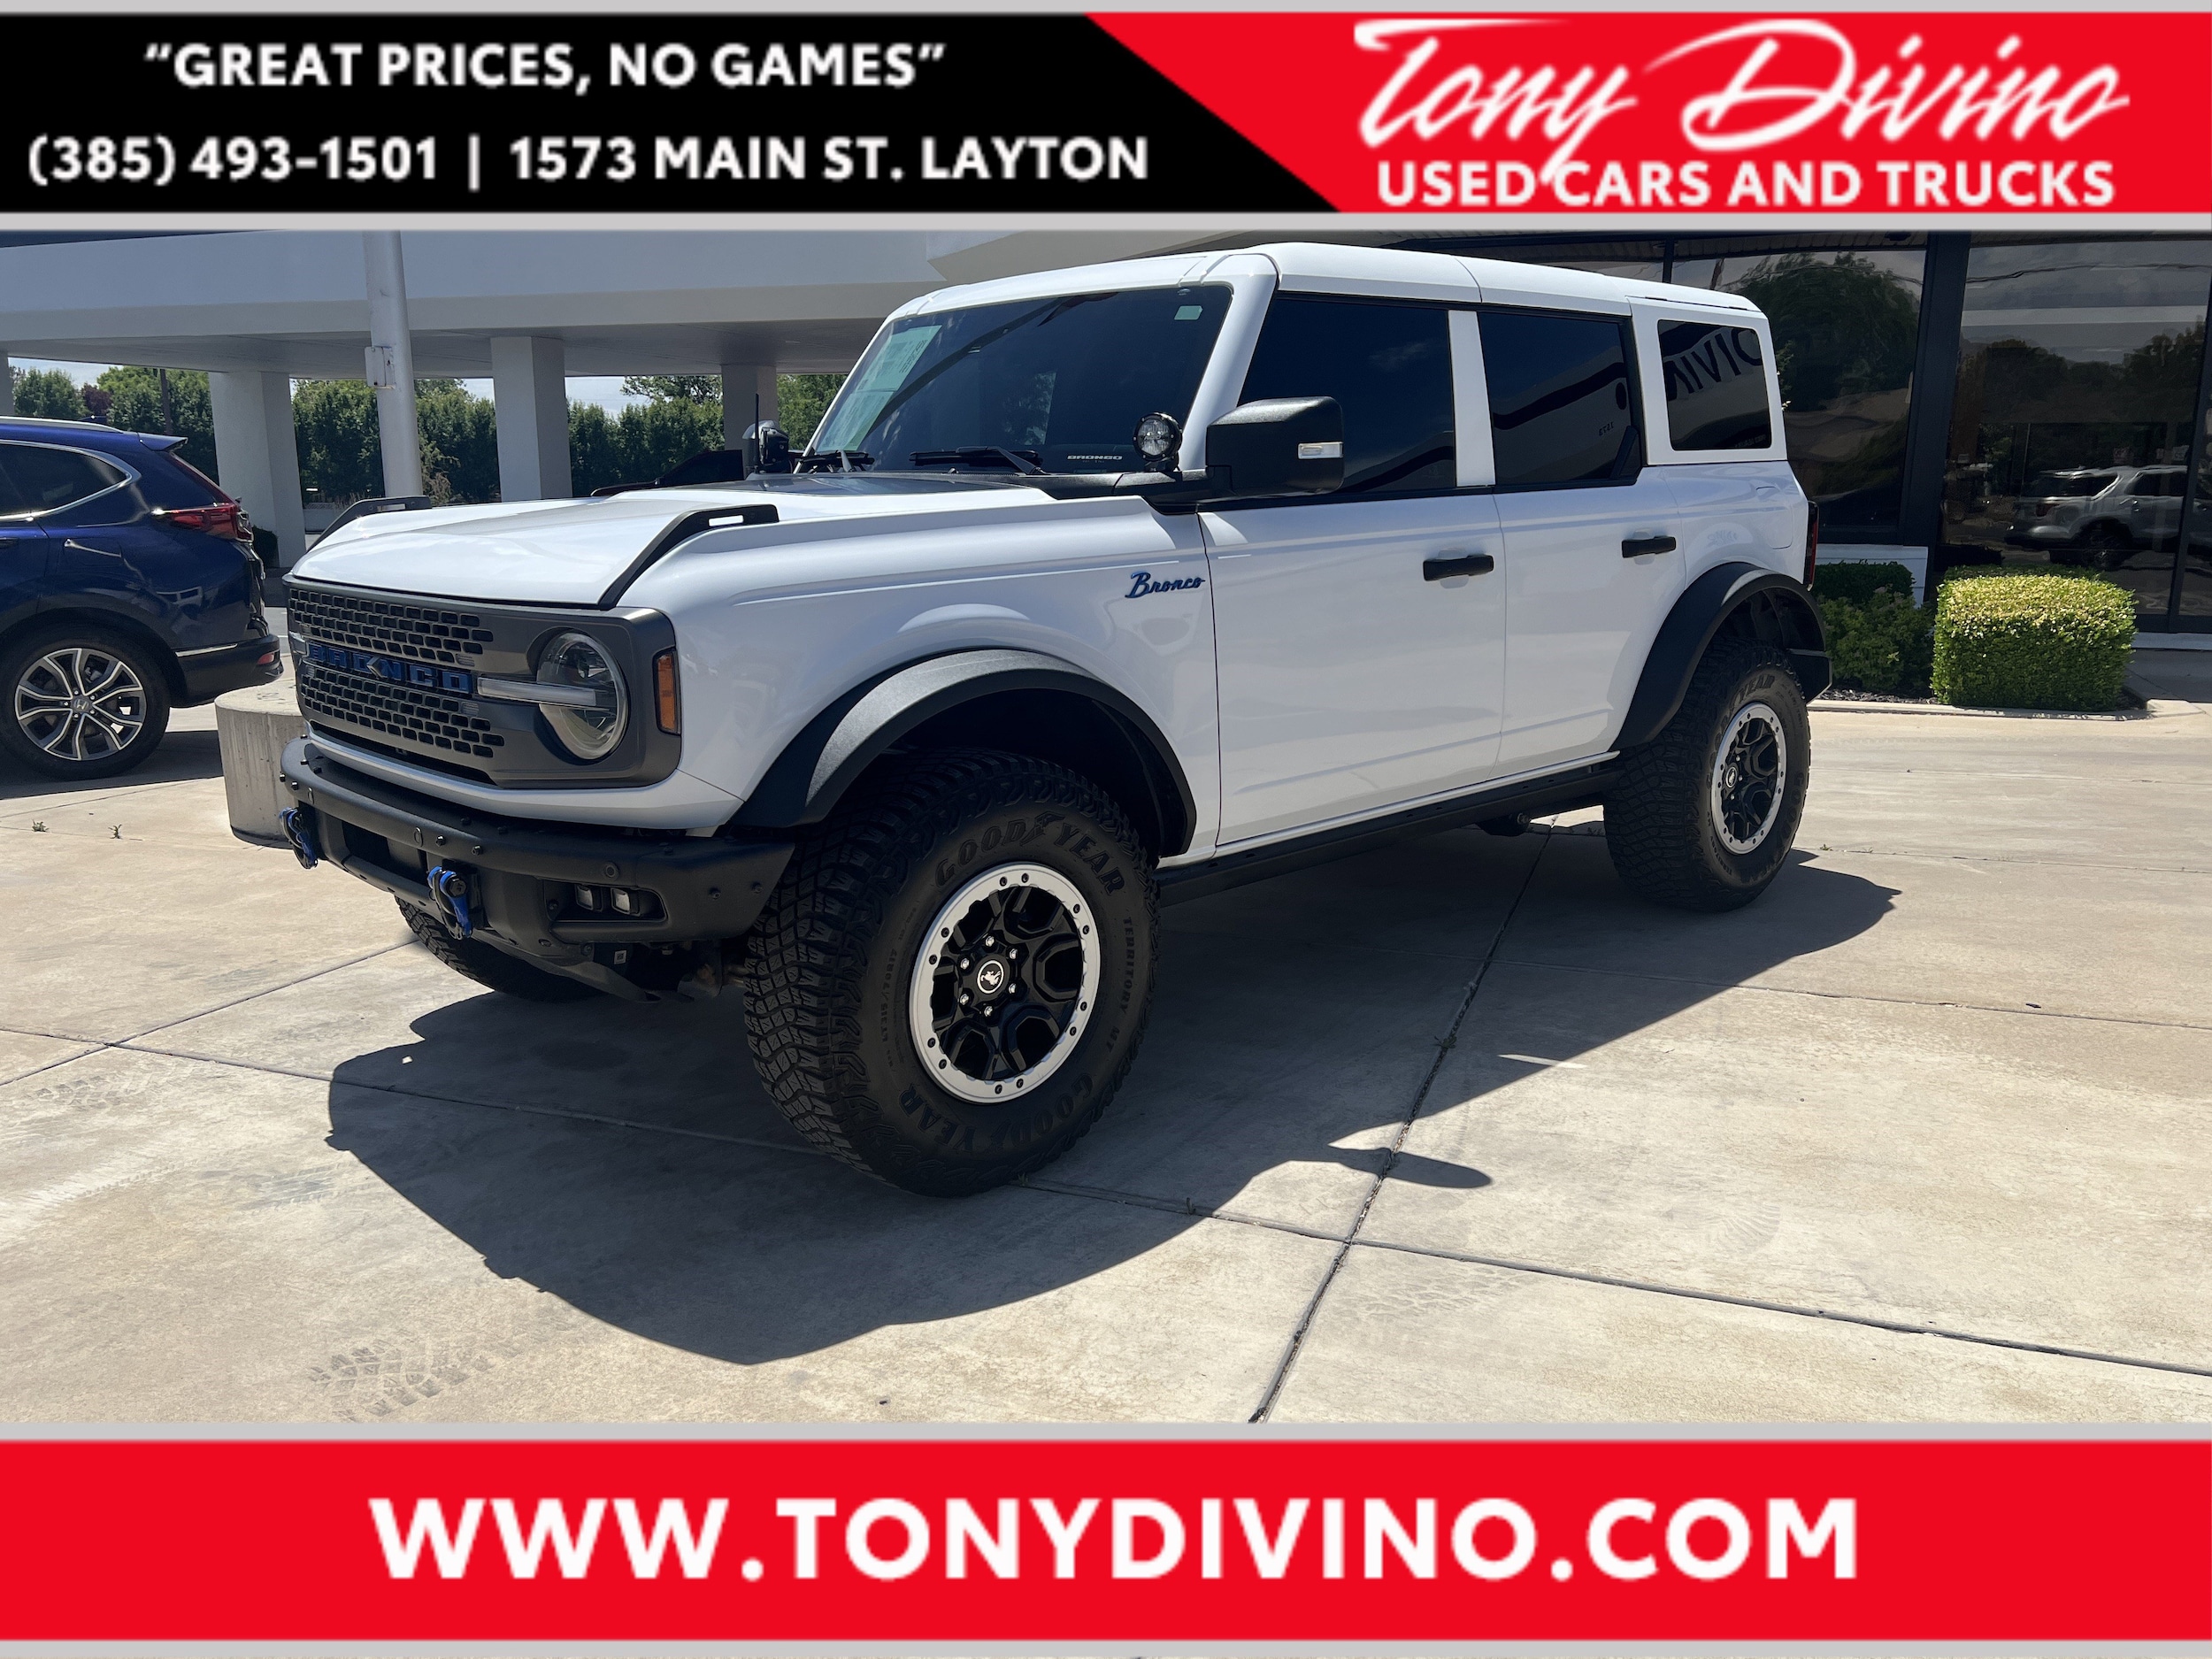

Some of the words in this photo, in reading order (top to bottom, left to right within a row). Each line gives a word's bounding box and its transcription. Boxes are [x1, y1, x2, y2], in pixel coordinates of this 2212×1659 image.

[1125, 571, 1206, 599] Bronco
[1118, 916, 1135, 1015] TERRITORY
[1105, 1025, 1121, 1053] MT
